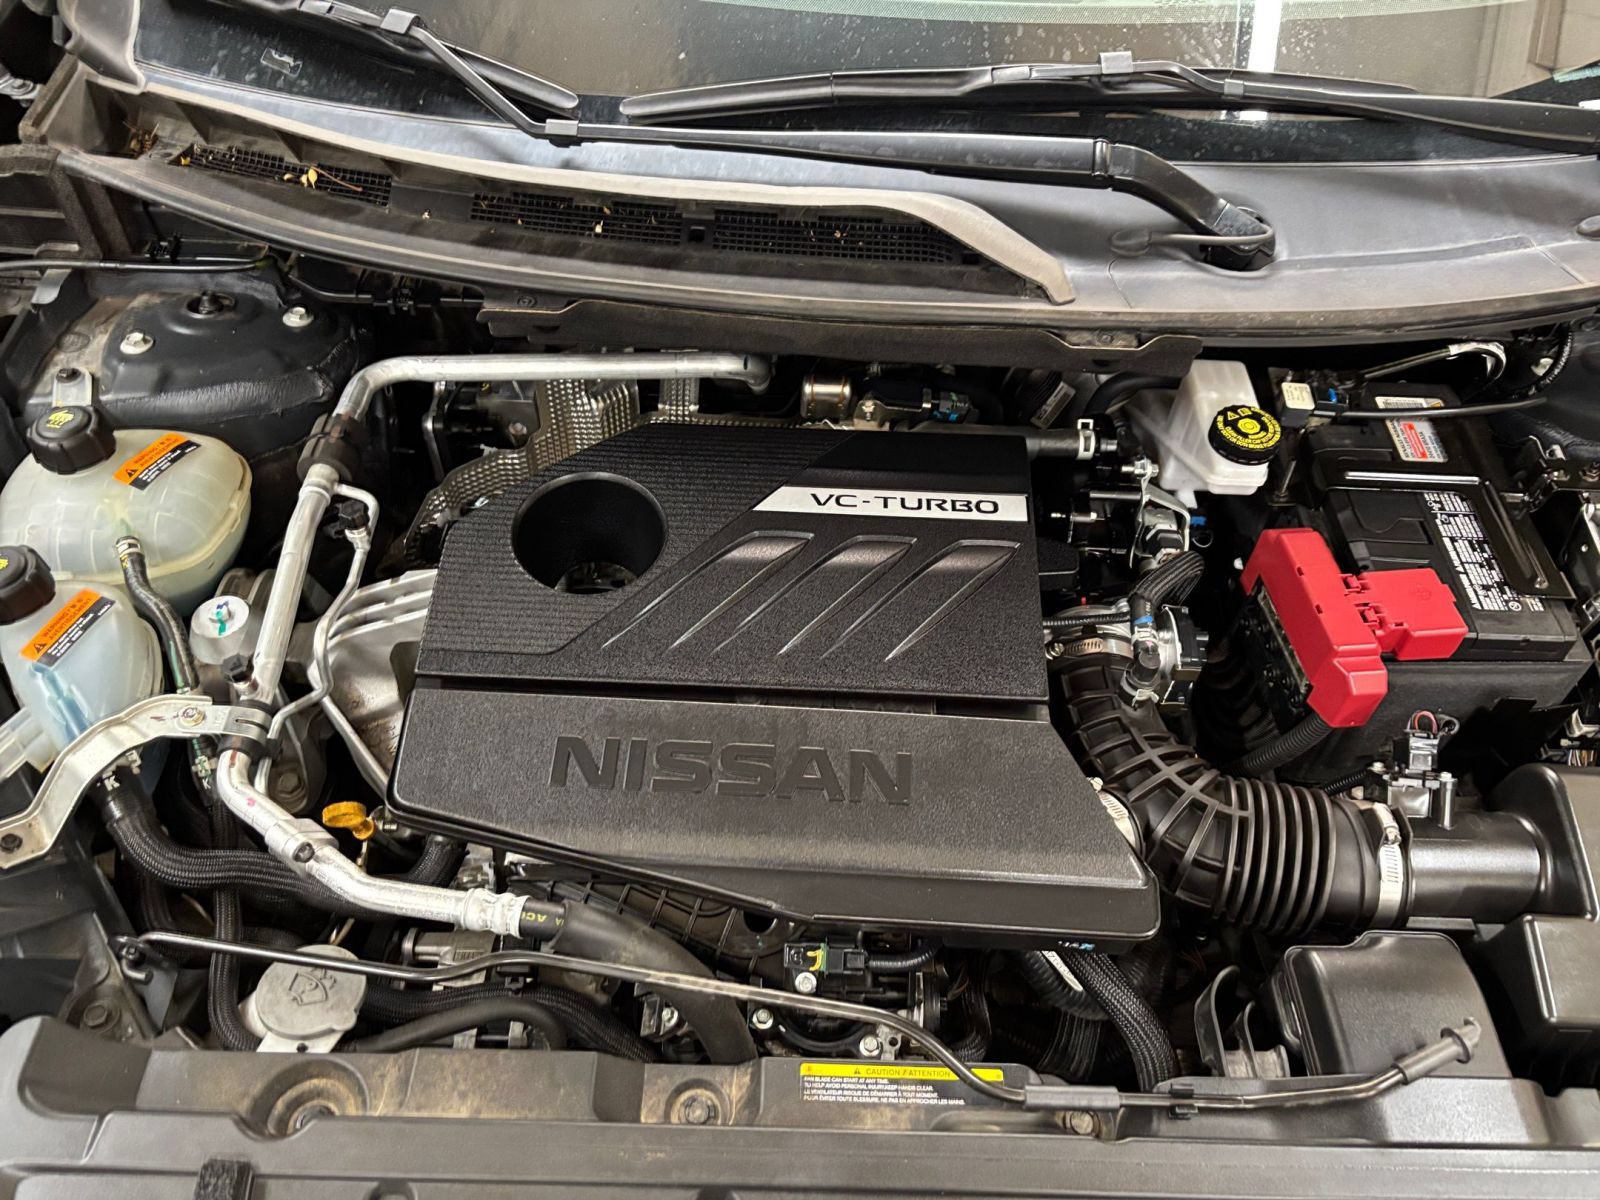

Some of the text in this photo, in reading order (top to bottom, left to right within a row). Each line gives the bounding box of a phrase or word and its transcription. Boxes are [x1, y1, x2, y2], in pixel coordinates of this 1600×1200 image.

[811, 493, 999, 515] VC-TURBO
[549, 736, 912, 805] NISSAN
[866, 1067, 900, 1076] CAUTION
[908, 1068, 951, 1078] ATTENTION
